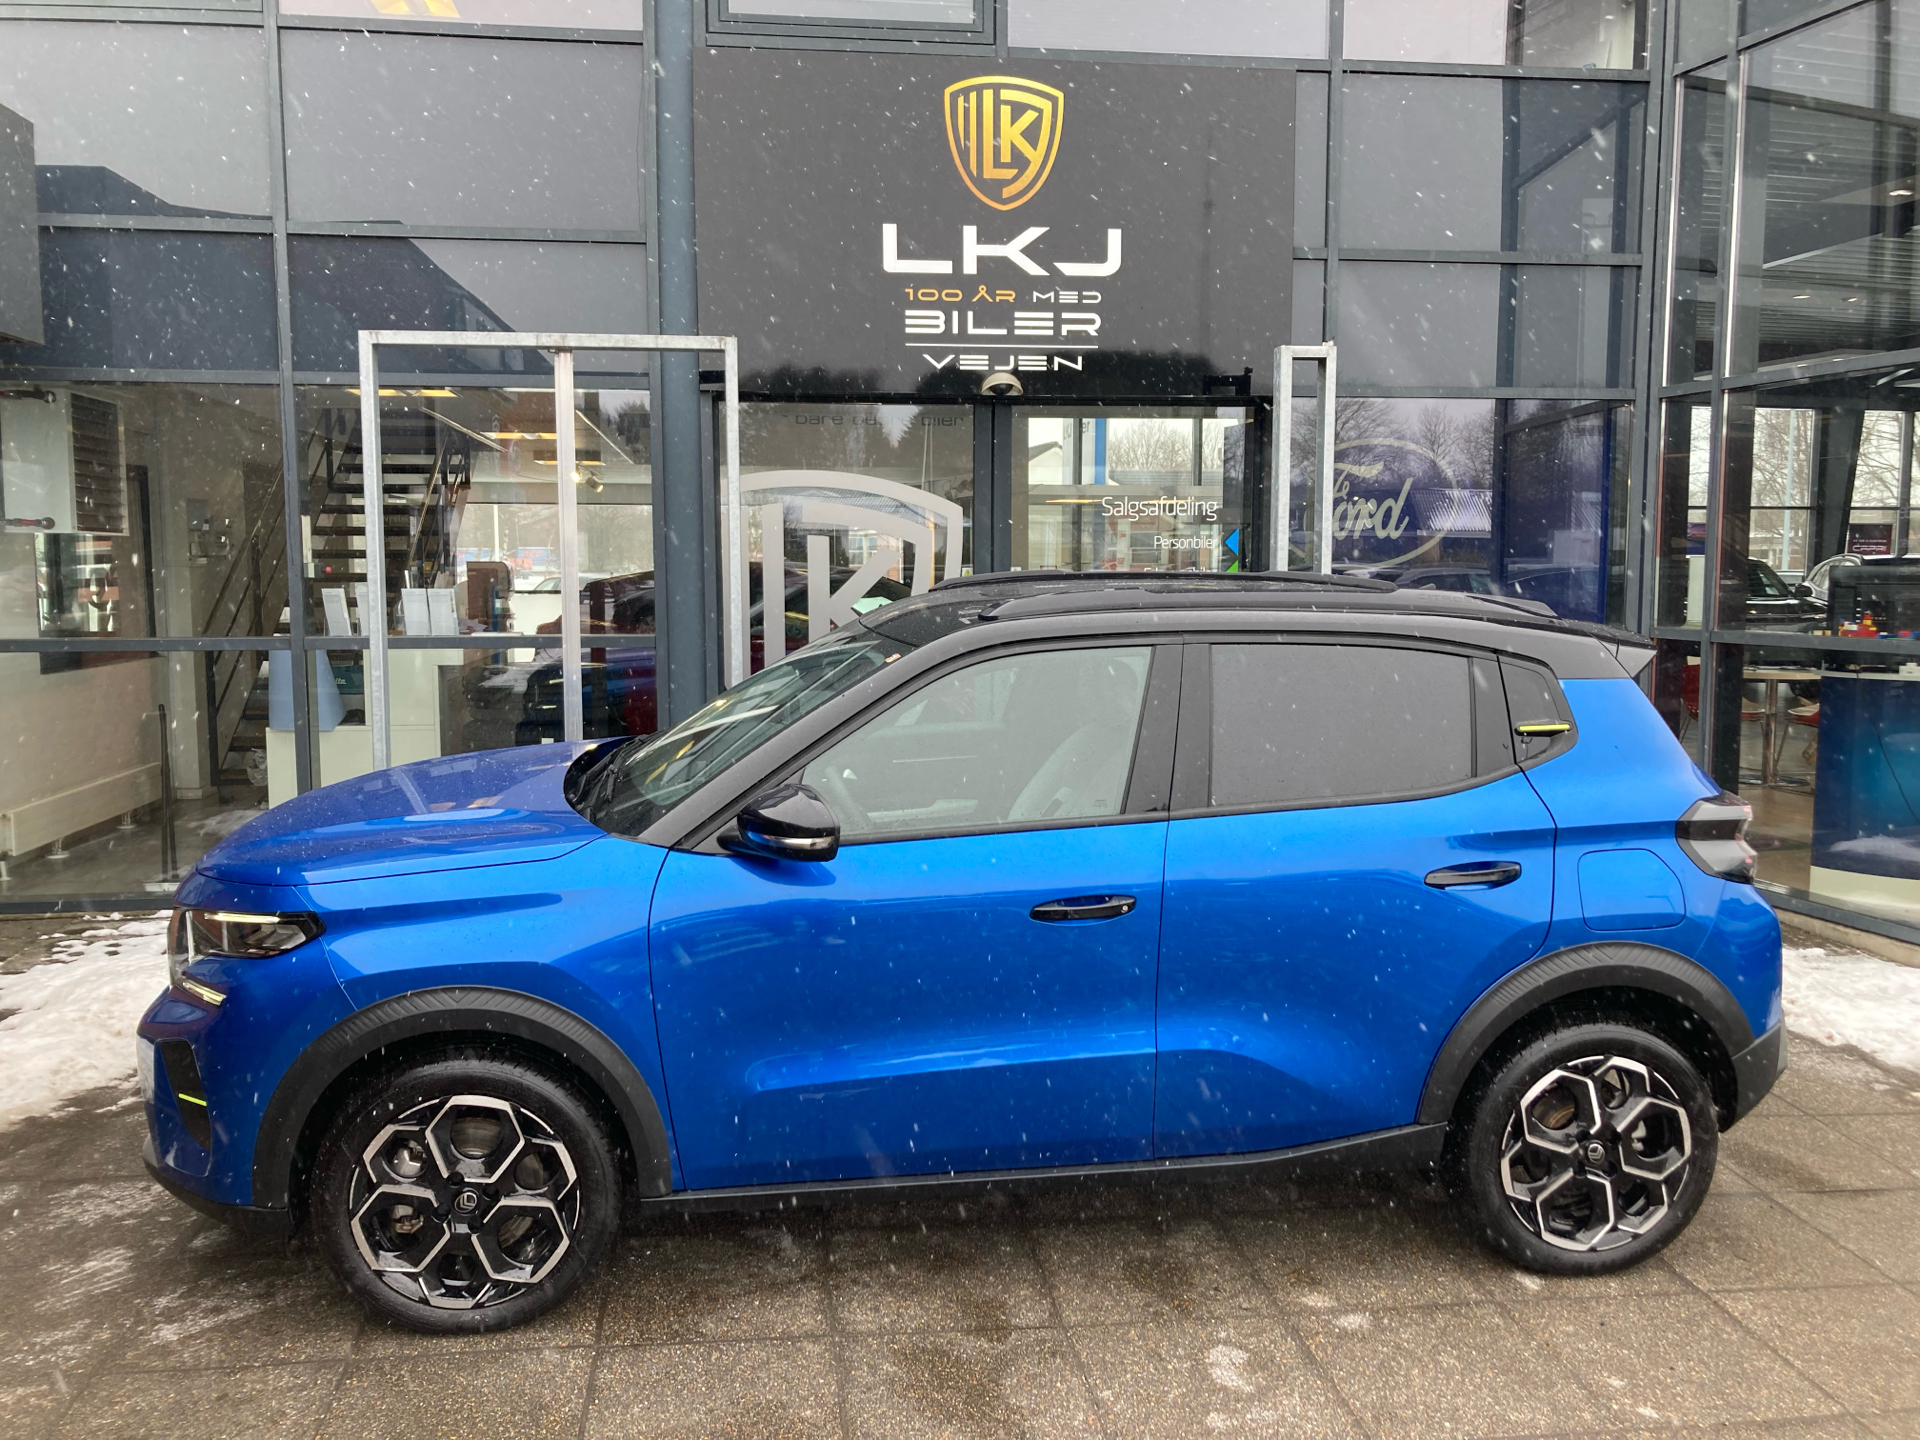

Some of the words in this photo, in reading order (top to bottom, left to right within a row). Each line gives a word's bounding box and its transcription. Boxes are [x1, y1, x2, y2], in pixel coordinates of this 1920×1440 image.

[882, 223, 1122, 277] LKJ
[904, 288, 963, 302] 100
[971, 284, 1016, 303] ÅR
[1032, 290, 1102, 304] MED
[904, 309, 1102, 336] BILER
[922, 353, 1083, 371] VEJEN
[1101, 495, 1218, 522] Salgsafdeling
[1153, 535, 1219, 549] Personbiler
